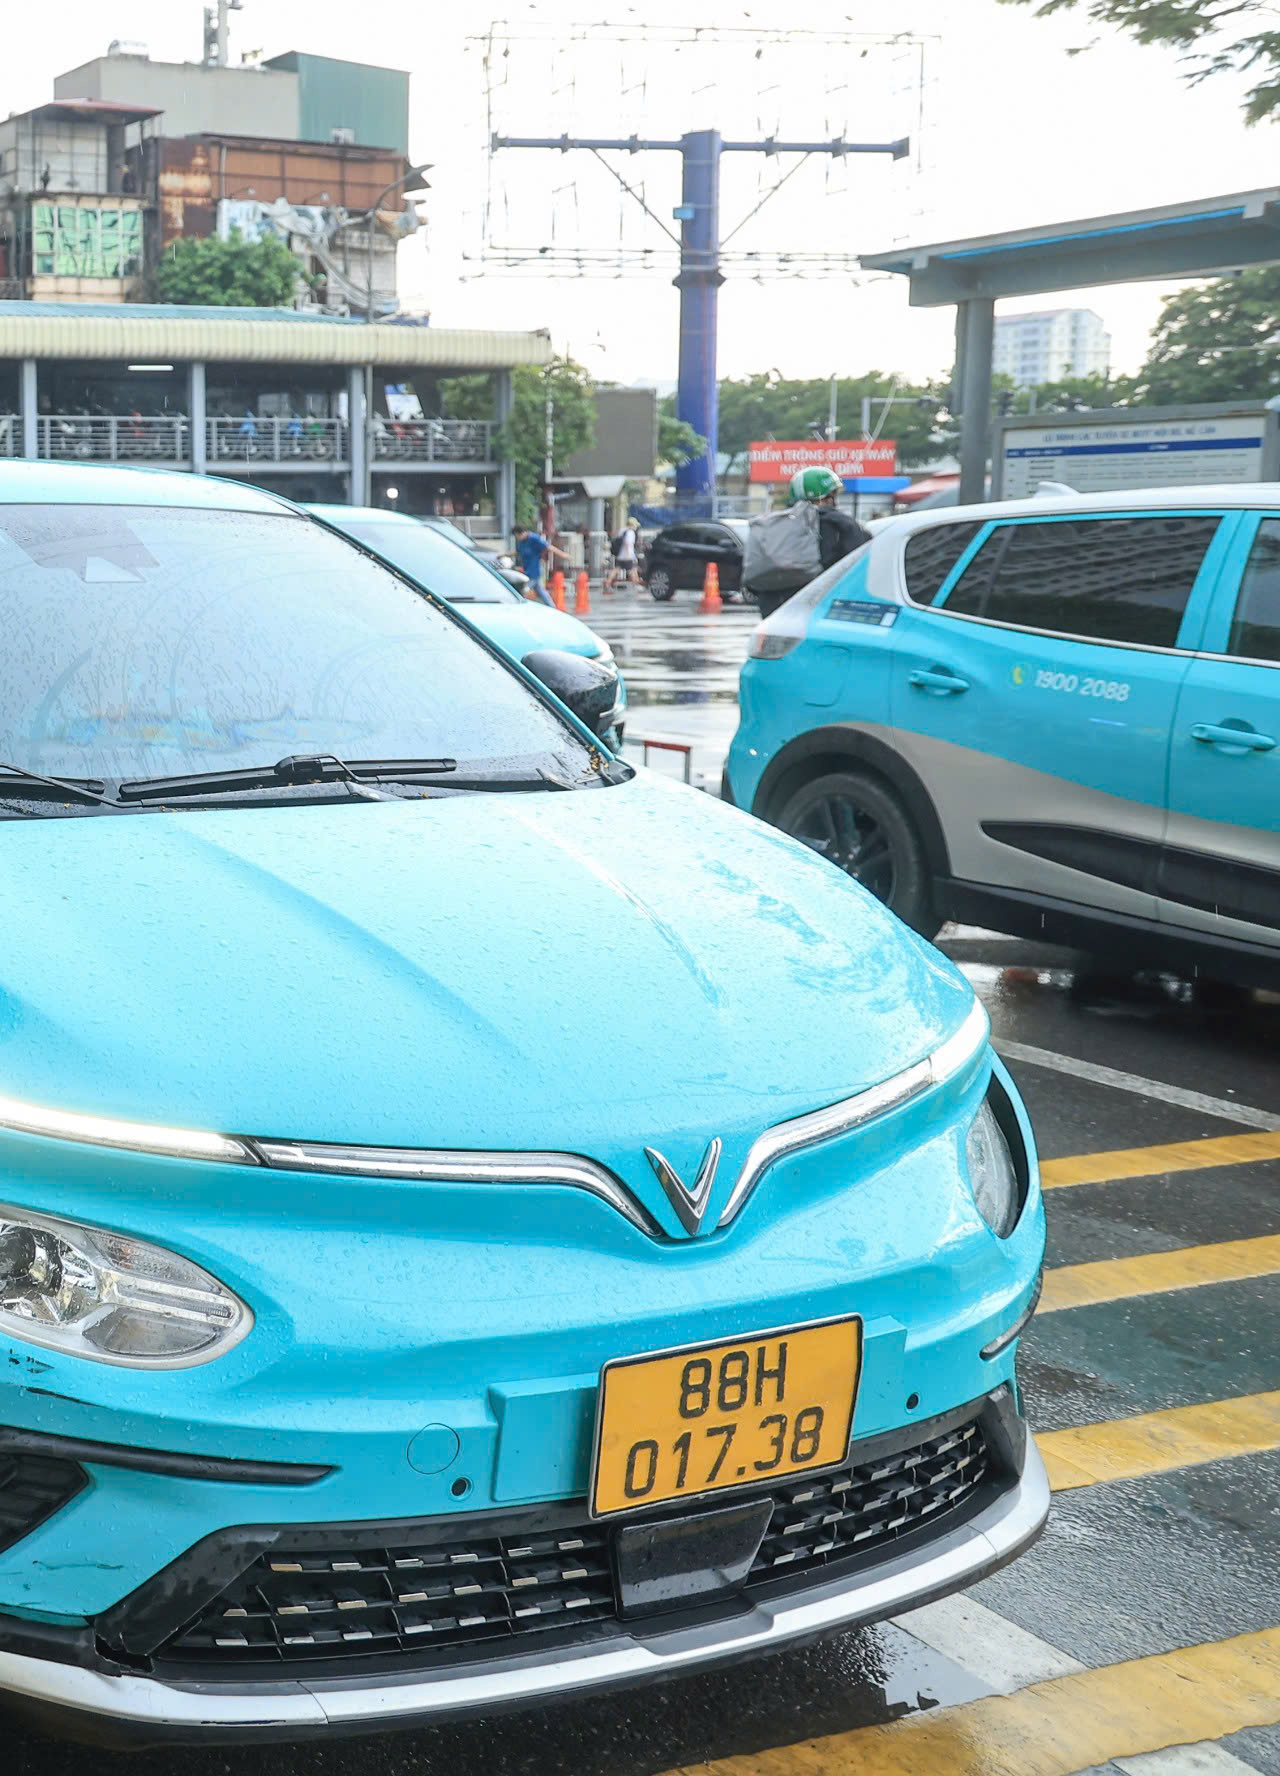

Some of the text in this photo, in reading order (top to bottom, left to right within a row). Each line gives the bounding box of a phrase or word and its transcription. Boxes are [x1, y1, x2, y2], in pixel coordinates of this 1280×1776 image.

[1035, 669, 1130, 701] 1900 2088
[678, 1342, 788, 1419] 88H
[624, 1406, 824, 1499] 017.38
